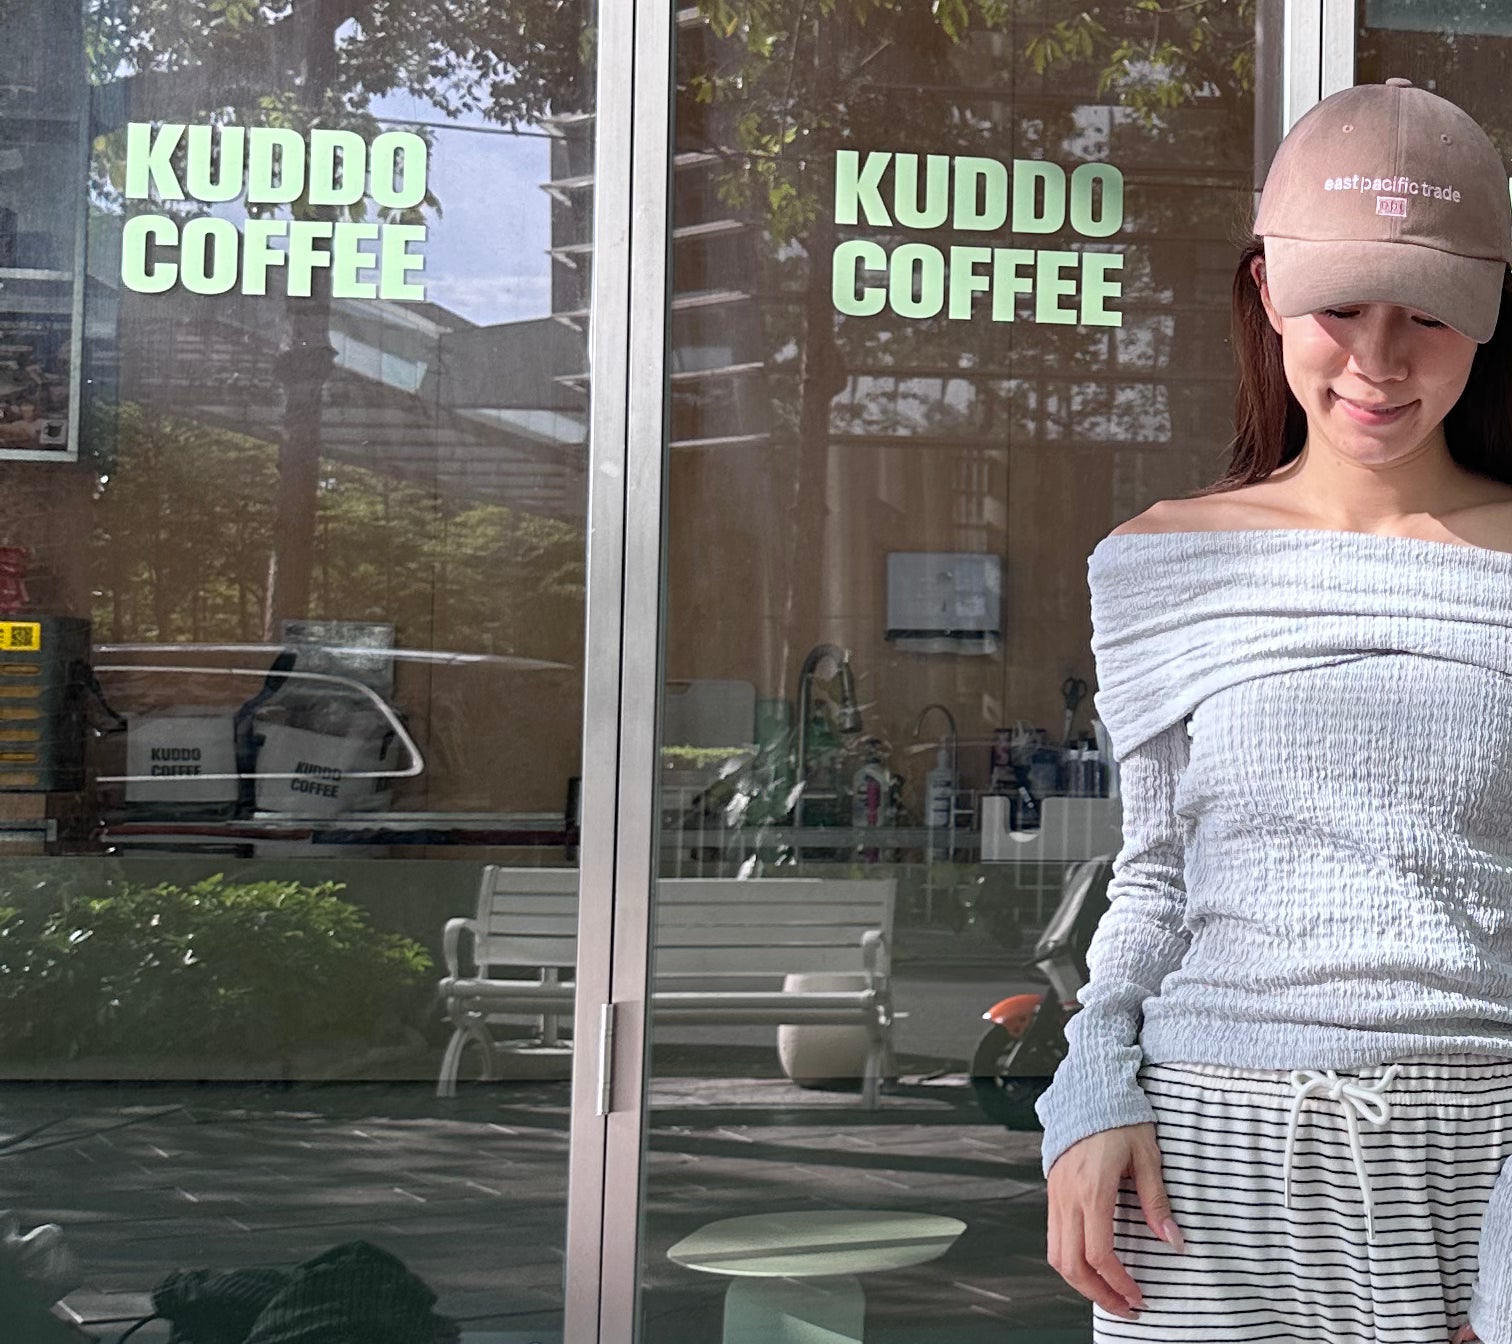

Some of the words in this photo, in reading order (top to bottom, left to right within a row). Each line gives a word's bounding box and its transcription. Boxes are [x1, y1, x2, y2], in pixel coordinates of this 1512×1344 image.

[125, 123, 428, 209] KUDDO
[834, 150, 1124, 238] KUDDO
[1324, 174, 1359, 191] east
[1360, 175, 1419, 194] pacific
[1421, 181, 1462, 203] trade
[122, 215, 427, 300] COFFEE
[832, 241, 1123, 328] COFFEE
[151, 747, 201, 761] KUDDO
[151, 764, 201, 777] COFFEE
[291, 778, 340, 798] COFFEE
